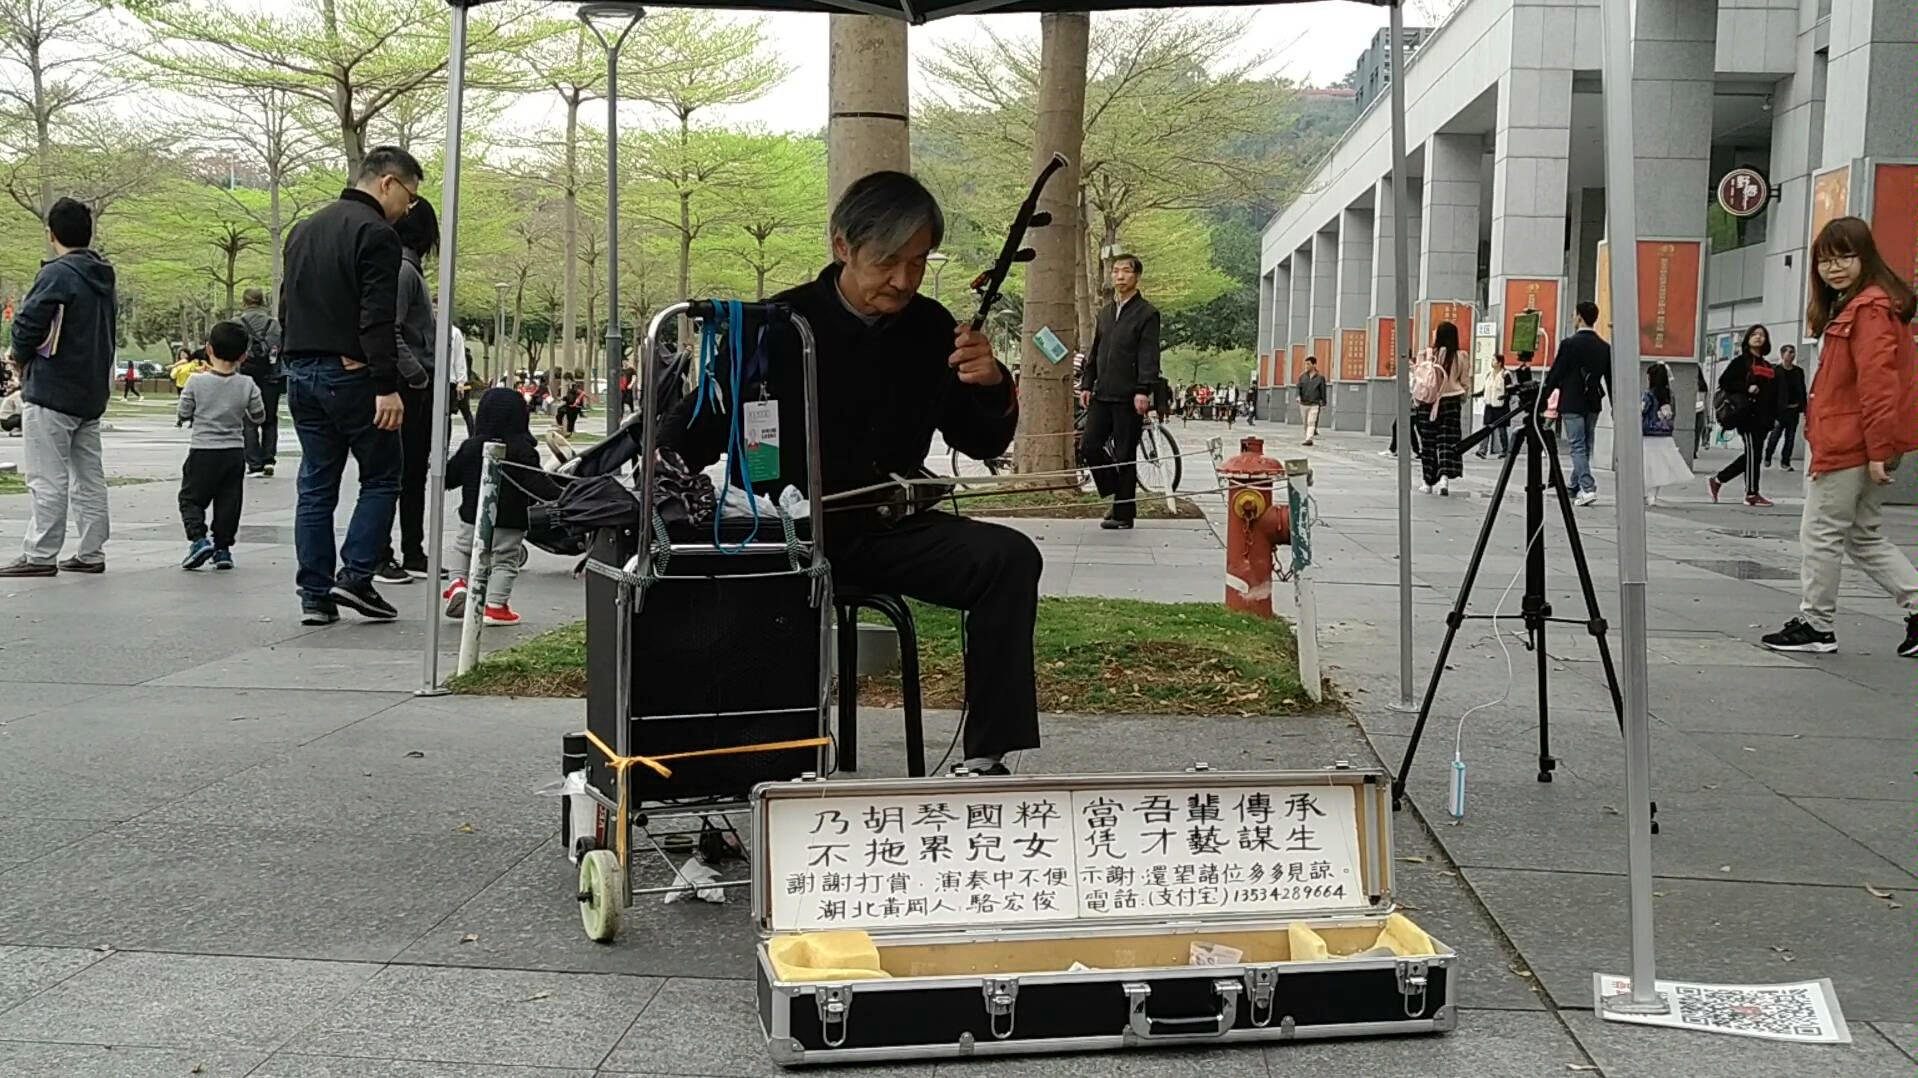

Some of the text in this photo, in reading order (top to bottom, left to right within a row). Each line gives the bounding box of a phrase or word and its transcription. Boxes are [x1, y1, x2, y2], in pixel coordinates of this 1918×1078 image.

[808, 792, 1327, 835] 乃胡琴國粹 當吾輩傳承
[807, 832, 1059, 868] 不拖累兒女
